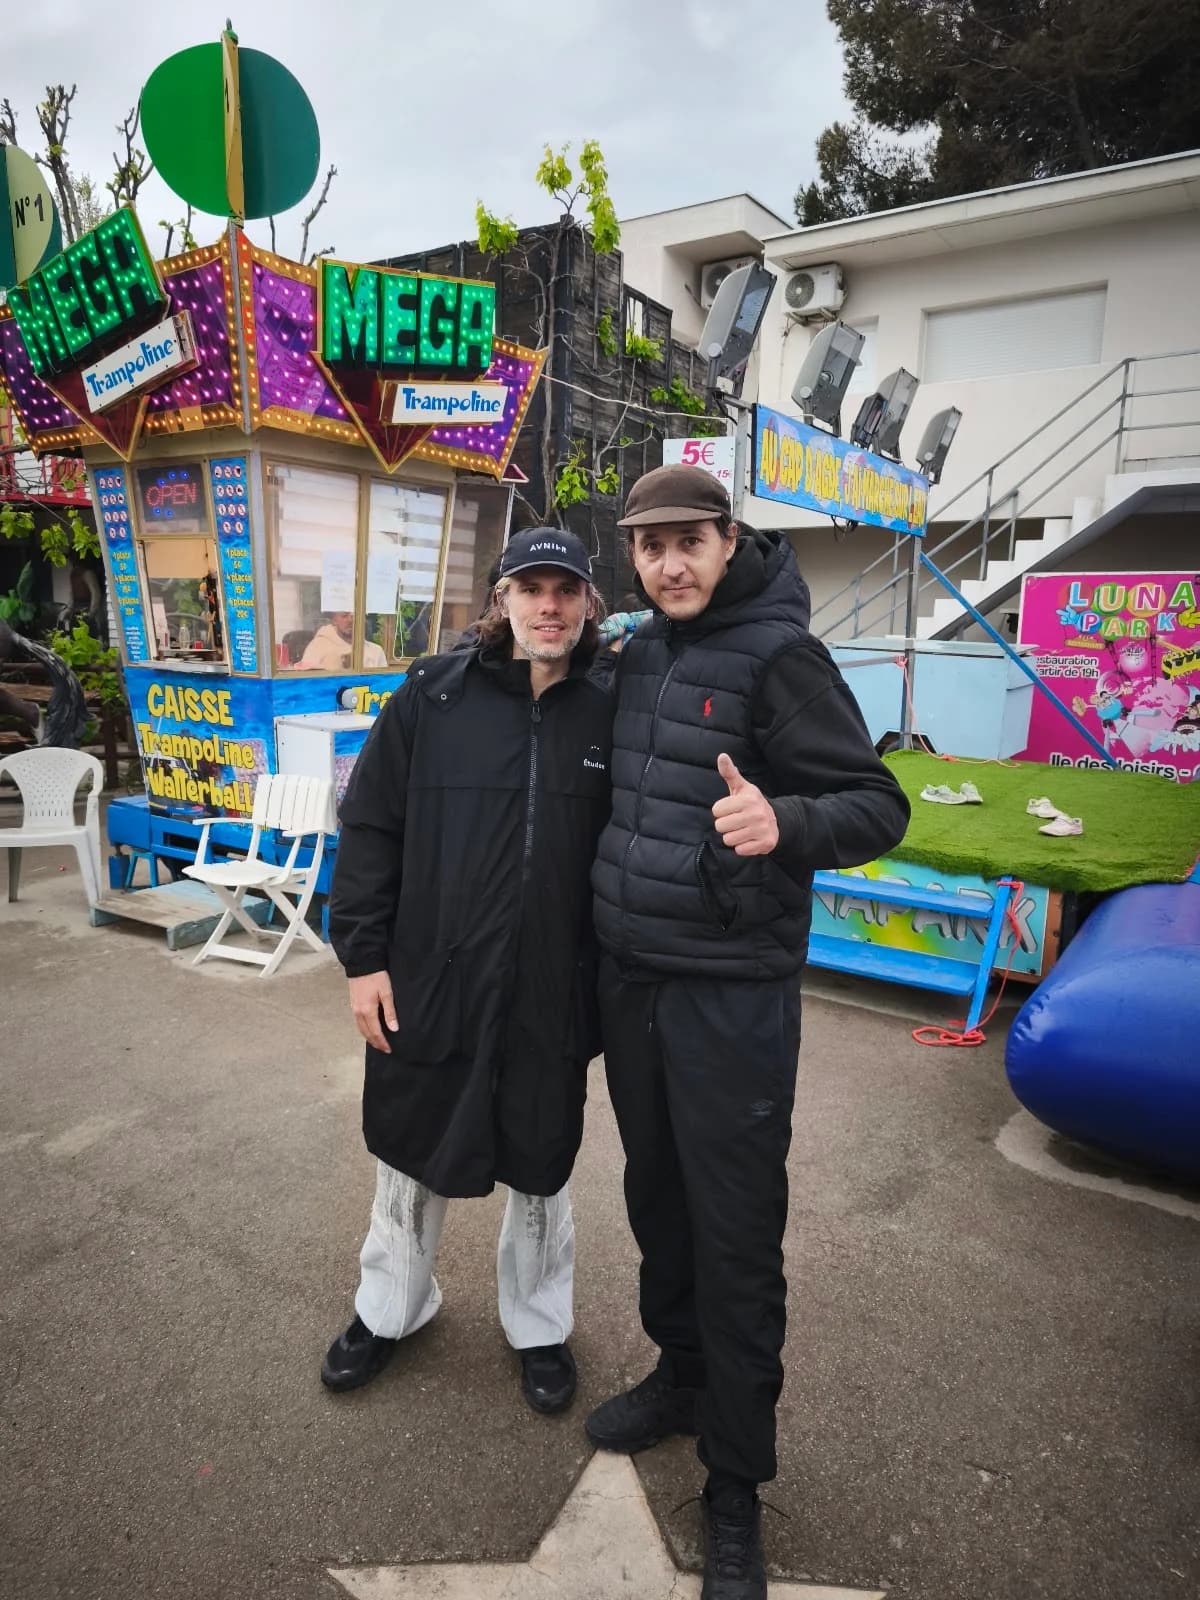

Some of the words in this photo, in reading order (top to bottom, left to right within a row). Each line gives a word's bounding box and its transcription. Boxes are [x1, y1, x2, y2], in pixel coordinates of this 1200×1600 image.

[34, 193, 44, 222] 1
[7, 207, 162, 375] MEGA
[324, 264, 495, 368] MEGA
[86, 339, 174, 397] Trampoline
[402, 387, 501, 416] Trampoline
[681, 440, 715, 466] 5€
[760, 427, 778, 487] AU
[779, 434, 803, 493] CAP
[145, 482, 197, 507] OPEN
[1070, 580, 1197, 612] LUNA
[1081, 612, 1176, 640] PARK
[1064, 667, 1078, 677] de
[1082, 667, 1099, 678] 19h
[1052, 754, 1071, 767] Ile
